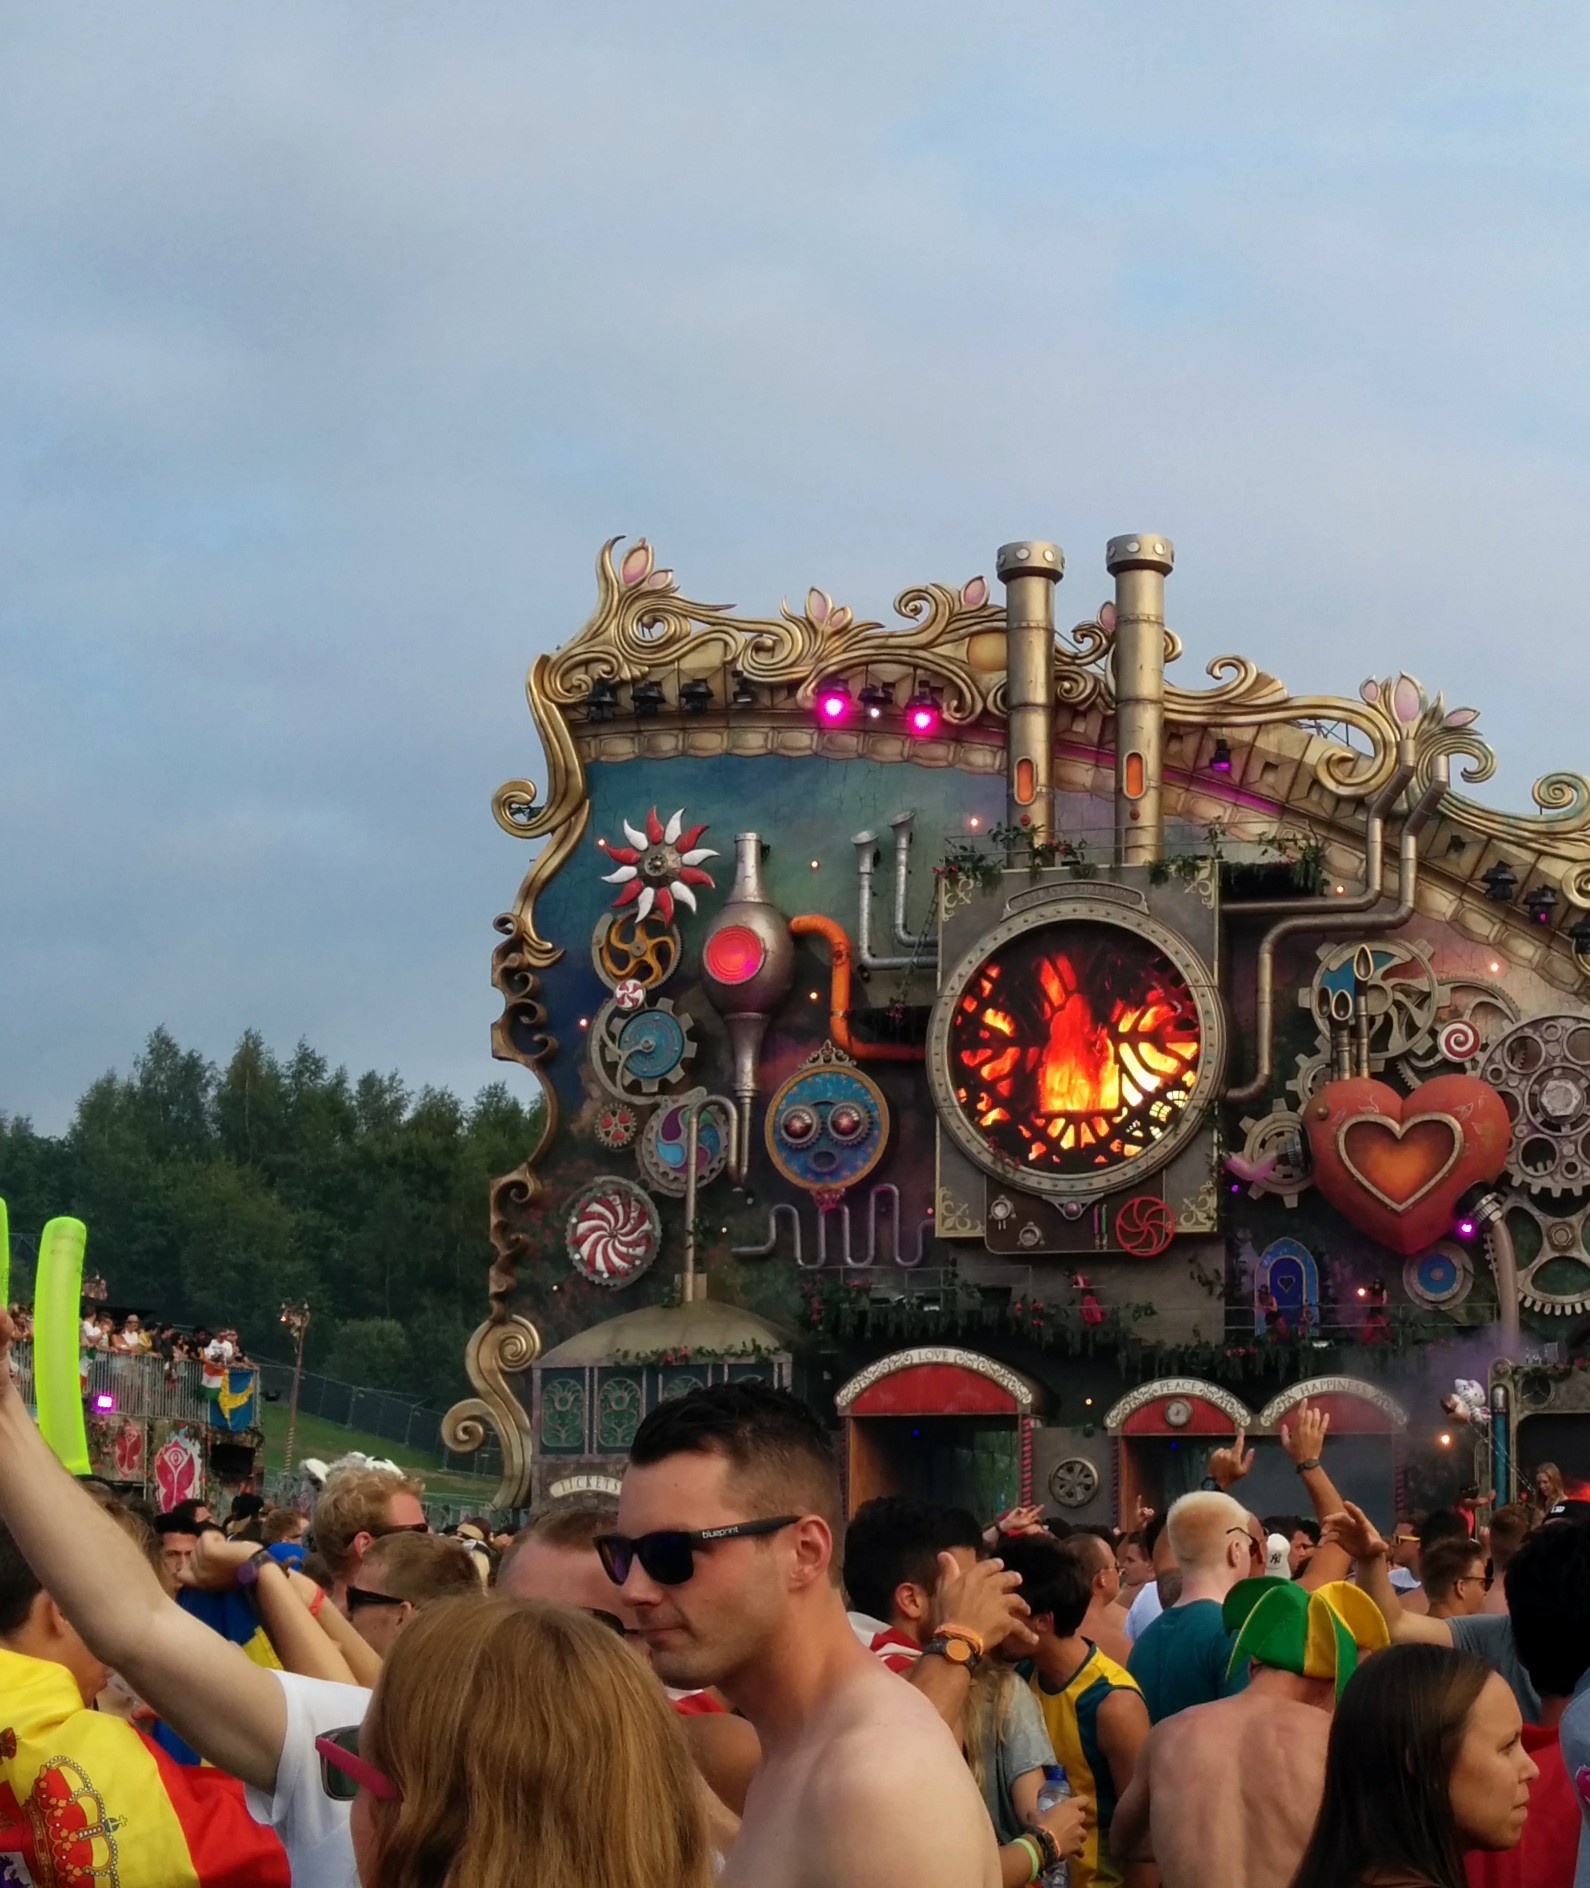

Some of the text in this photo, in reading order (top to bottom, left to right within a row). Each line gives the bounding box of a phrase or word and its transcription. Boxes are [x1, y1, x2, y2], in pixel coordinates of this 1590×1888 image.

[917, 1349, 949, 1361] LOVE
[1159, 1381, 1197, 1393] PEACE
[1300, 1379, 1368, 1397] HAPPINESS
[560, 1476, 620, 1493] TICKETS
